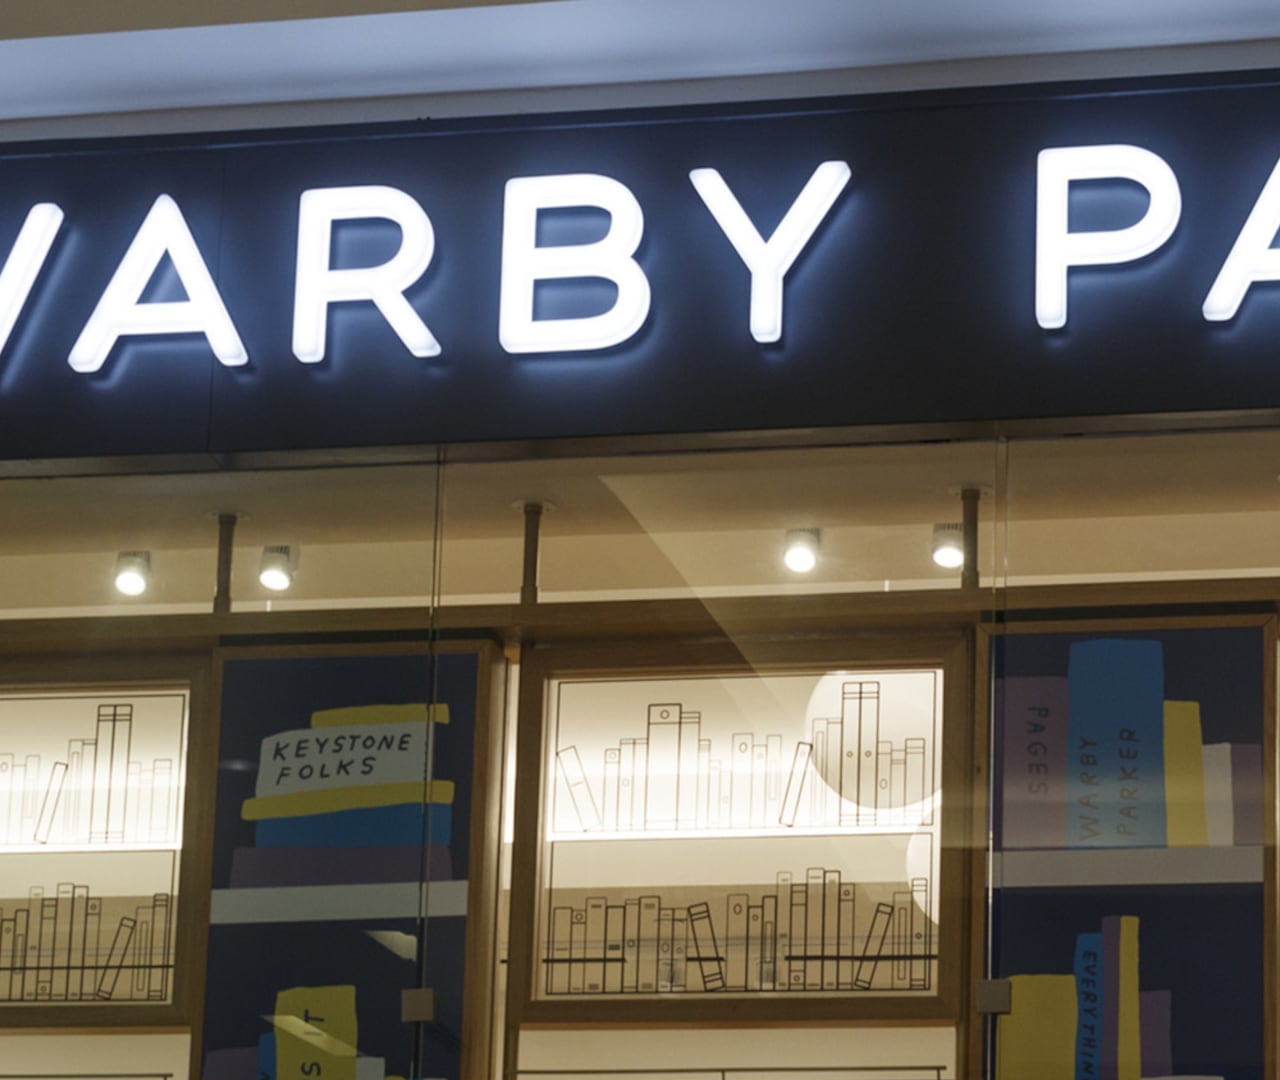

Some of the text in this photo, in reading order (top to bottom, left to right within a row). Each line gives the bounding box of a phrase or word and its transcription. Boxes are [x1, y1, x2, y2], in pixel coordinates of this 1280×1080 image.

[272, 734, 412, 761] KEYSTONE
[276, 757, 376, 786] FOLKS
[1025, 705, 1049, 794] PAGES
[1078, 735, 1100, 840] WARBY
[1116, 727, 1141, 836] PARKER
